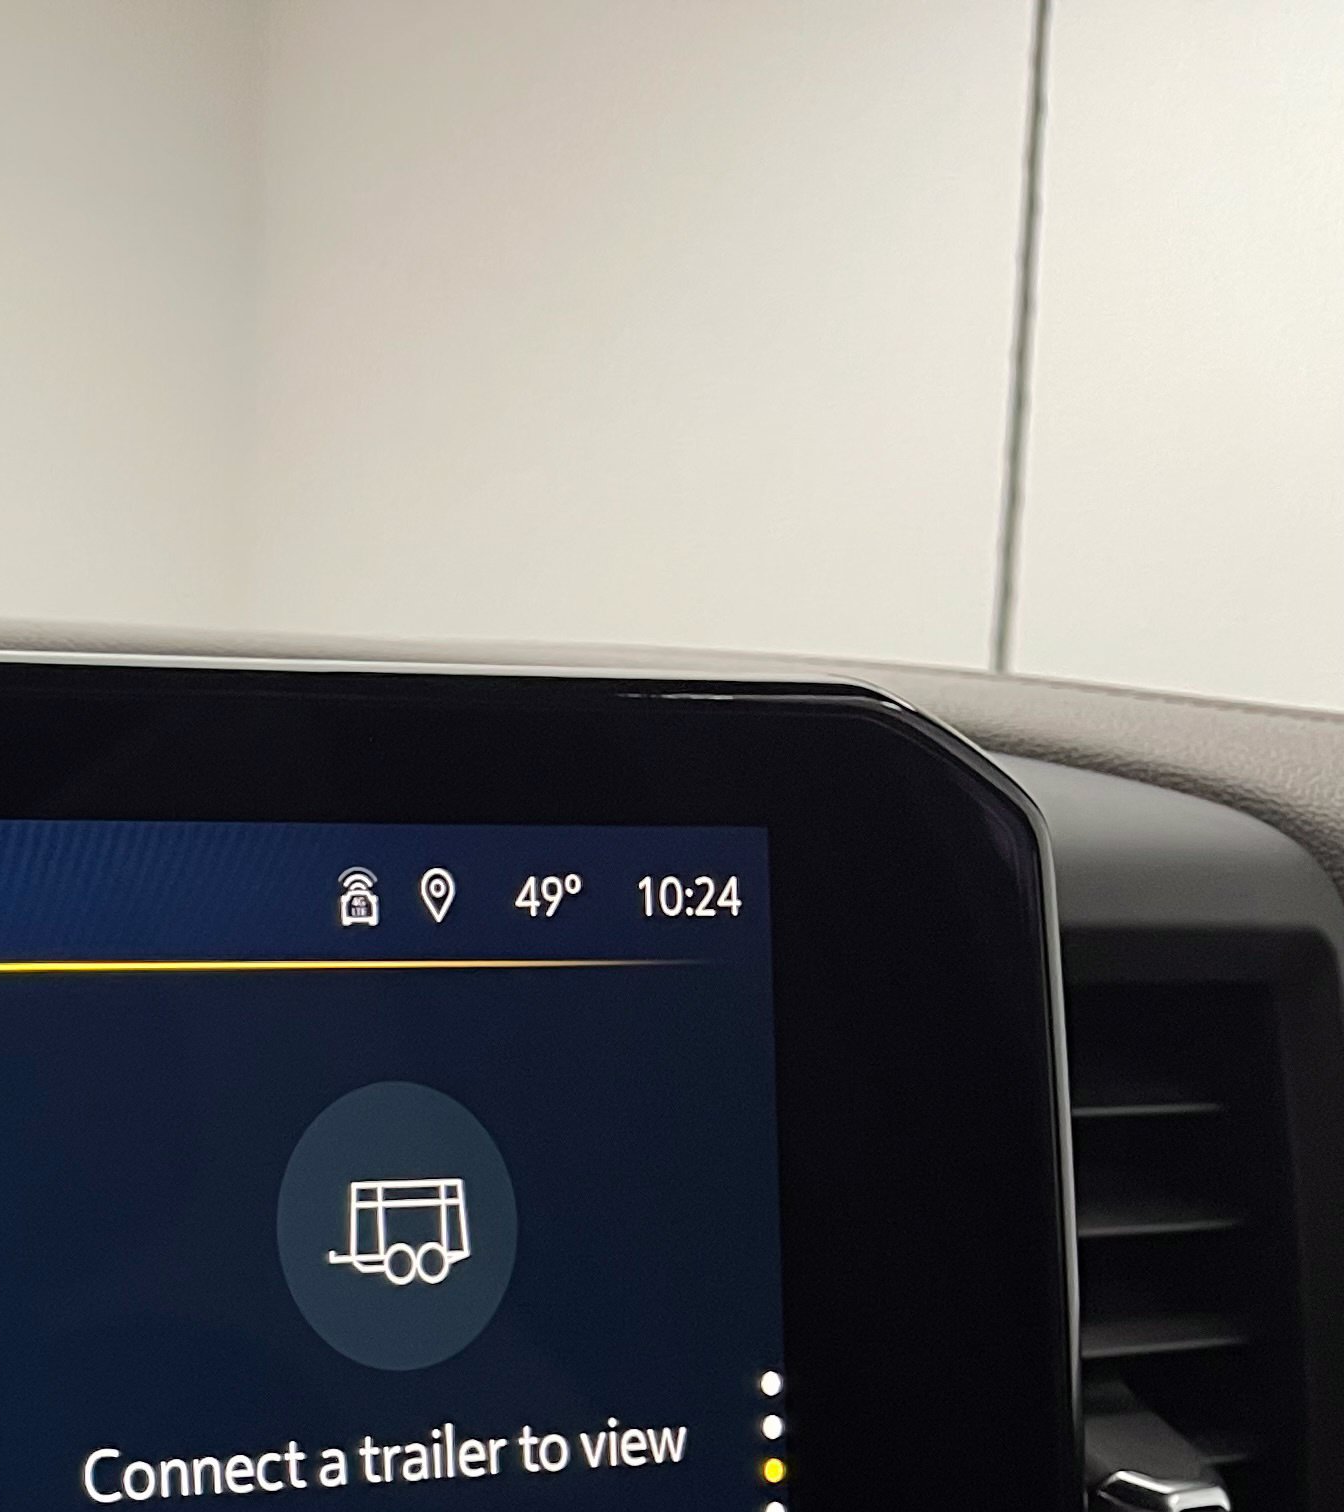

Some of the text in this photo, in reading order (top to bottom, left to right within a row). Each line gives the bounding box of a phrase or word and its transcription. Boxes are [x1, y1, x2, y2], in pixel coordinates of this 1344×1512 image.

[637, 874, 743, 918] 10:24
[83, 1416, 688, 1504] Connect a trailer to view
